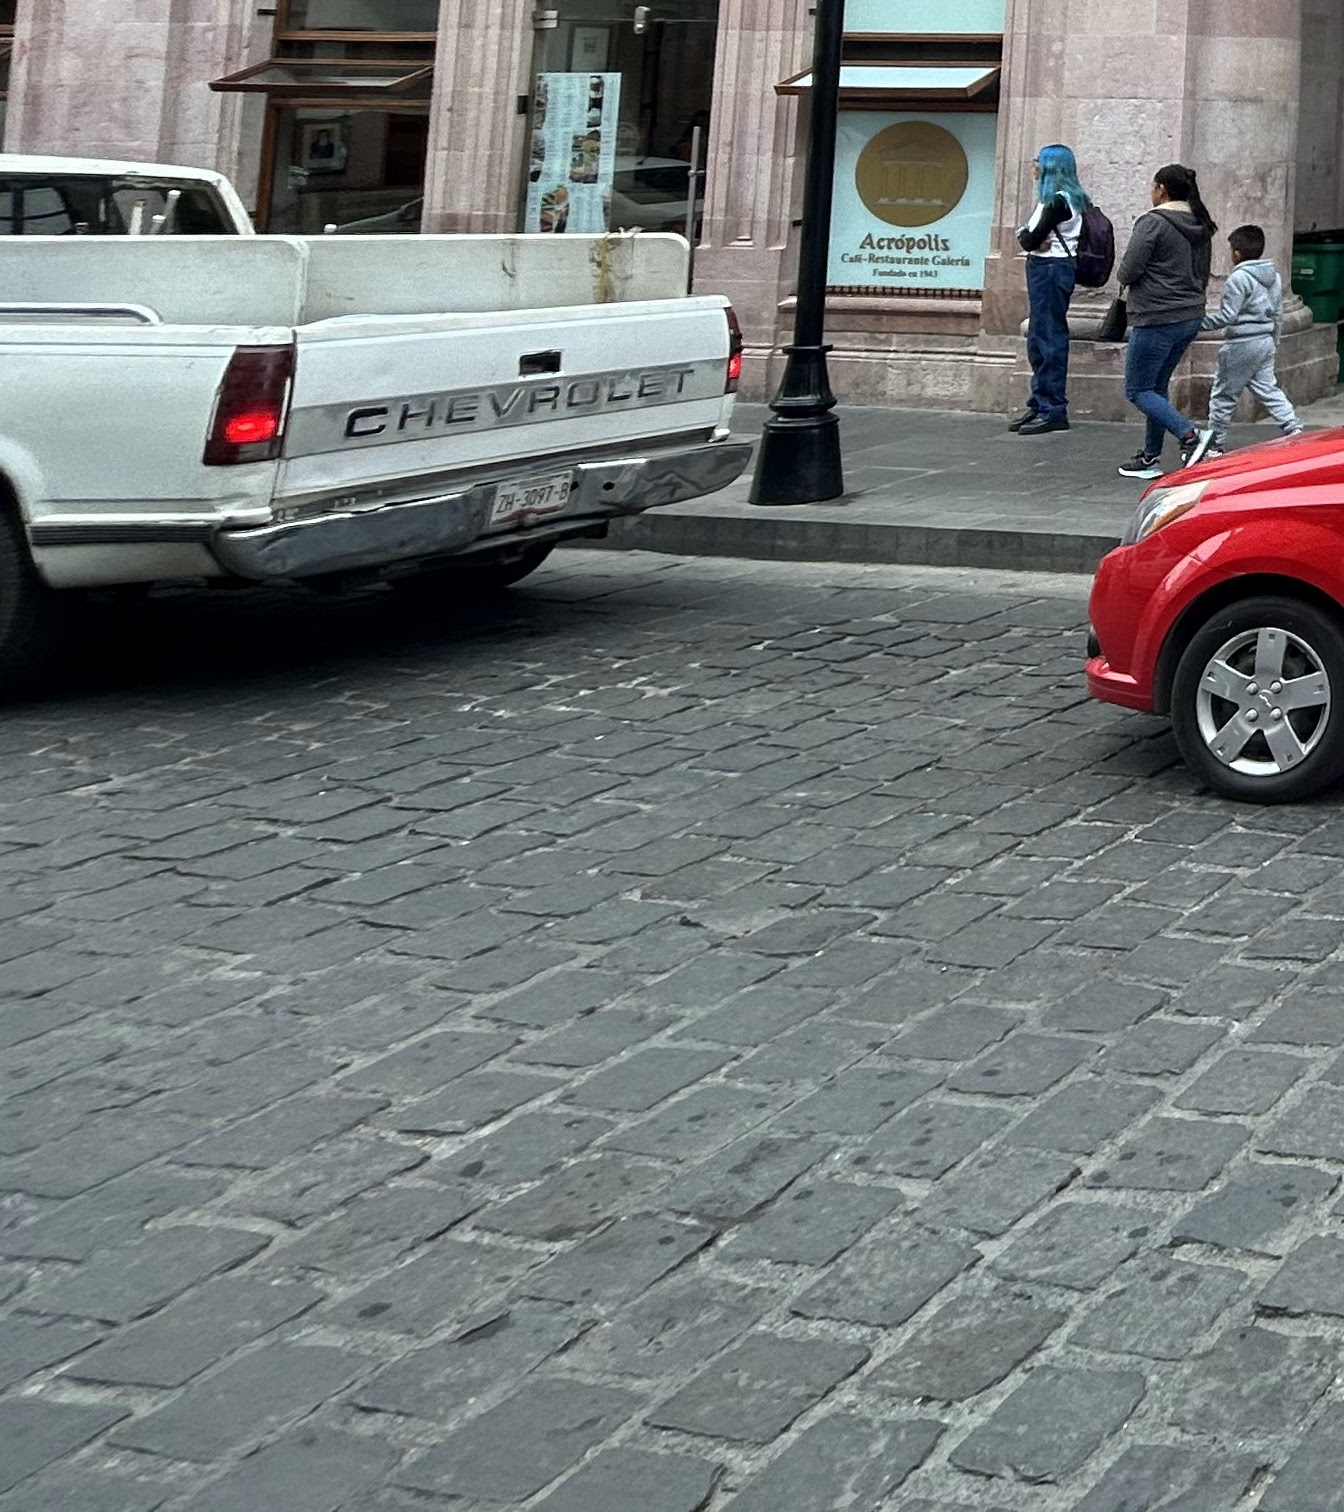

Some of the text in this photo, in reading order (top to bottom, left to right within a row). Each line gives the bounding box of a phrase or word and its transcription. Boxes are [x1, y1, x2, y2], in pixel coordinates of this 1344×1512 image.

[859, 232, 950, 253] Acrópolis
[932, 255, 970, 266] Galería
[345, 368, 695, 437] CHEVROLET
